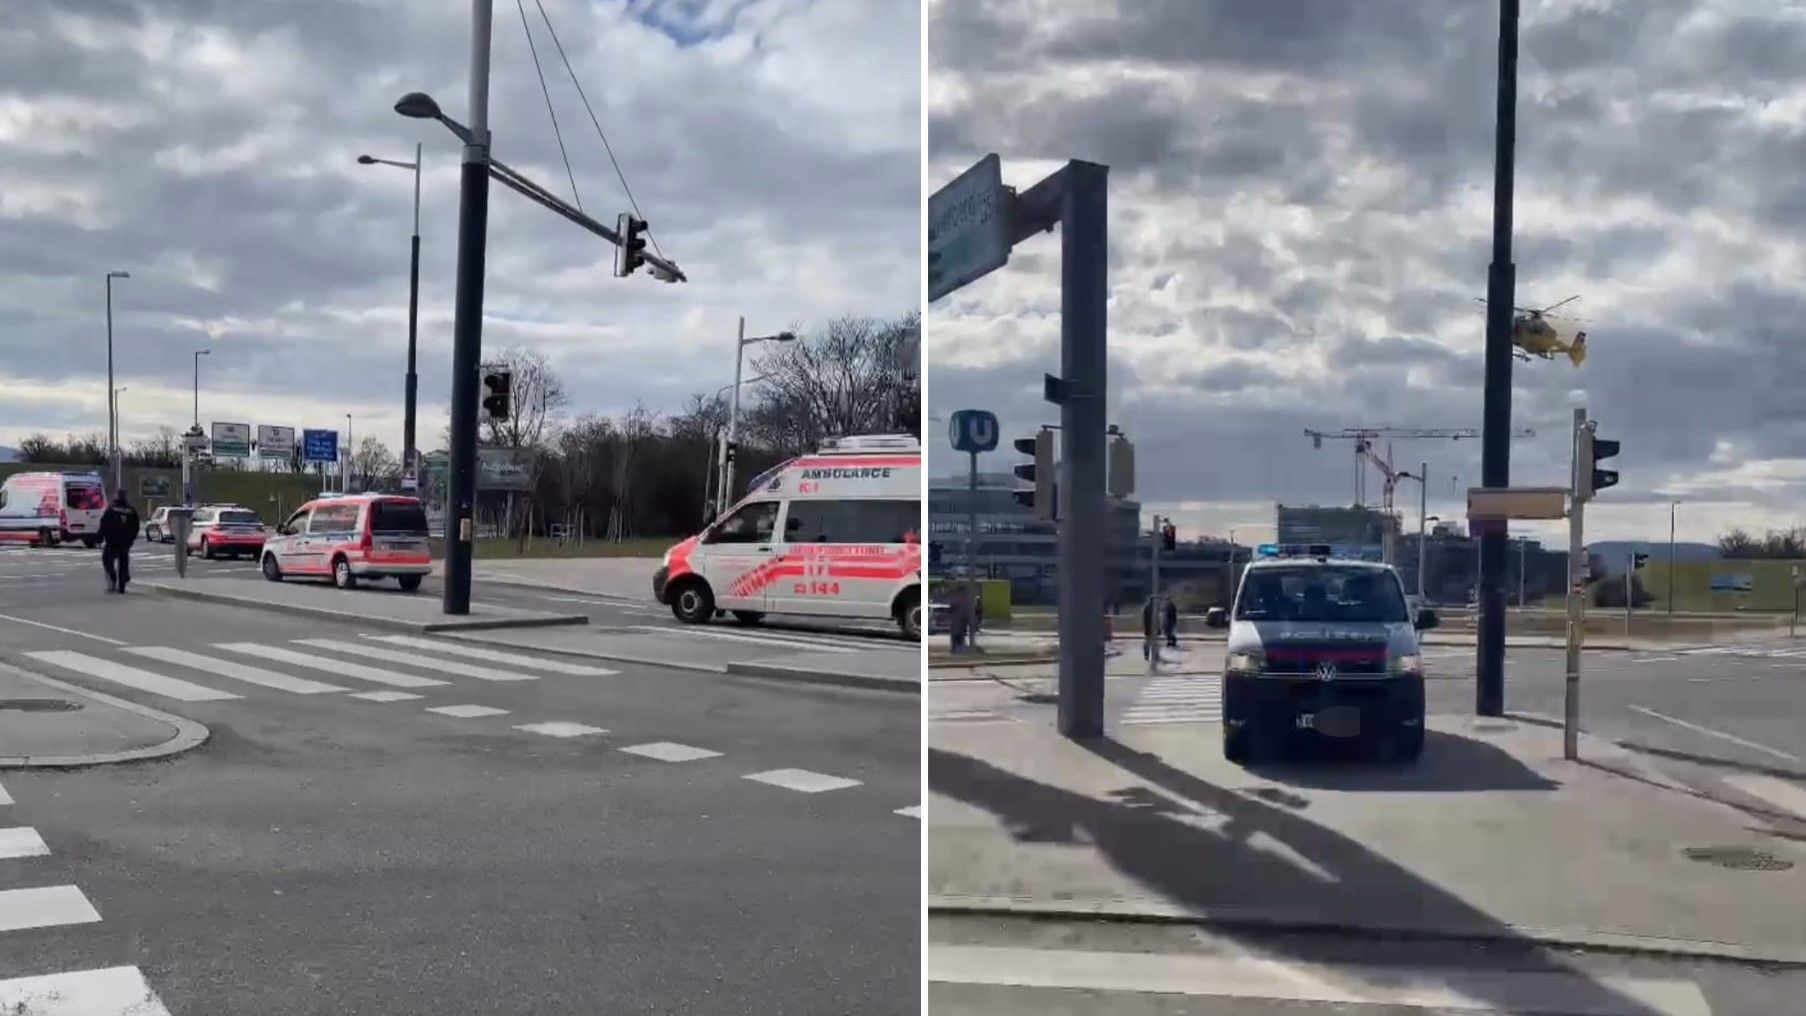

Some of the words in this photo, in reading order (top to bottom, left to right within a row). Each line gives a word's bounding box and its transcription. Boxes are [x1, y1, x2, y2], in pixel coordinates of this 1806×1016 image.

[969, 418, 992, 445] U
[801, 468, 890, 479] AMBULANCE
[811, 582, 839, 594] 144
